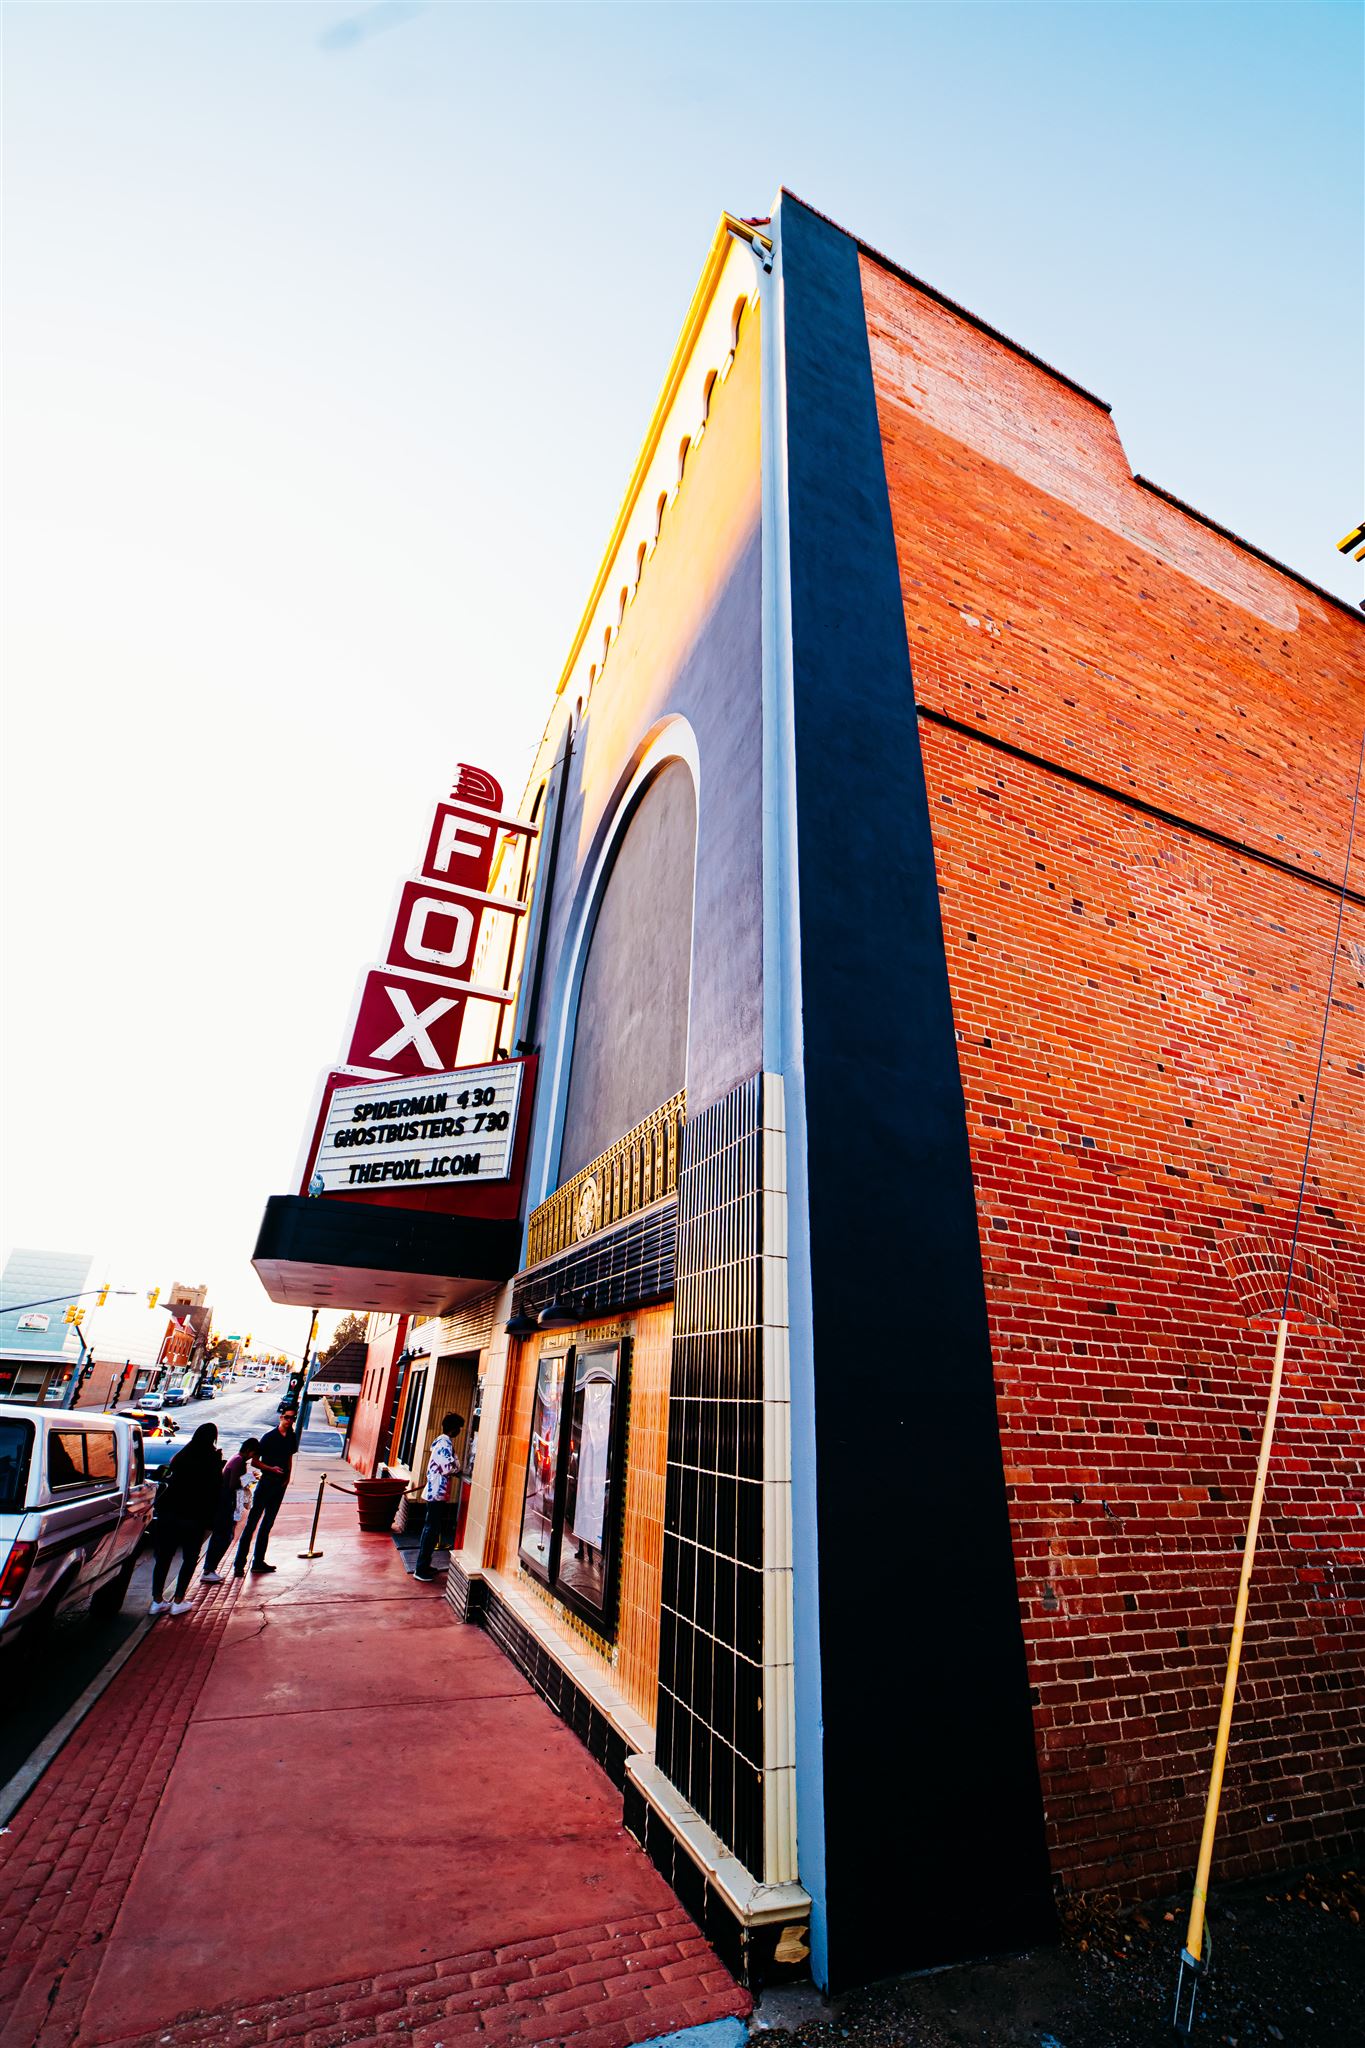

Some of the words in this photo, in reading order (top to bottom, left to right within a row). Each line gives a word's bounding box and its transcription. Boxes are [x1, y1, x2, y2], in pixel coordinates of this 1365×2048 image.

[369, 813, 491, 1070] FOX
[351, 1092, 447, 1122] SPIDERMAN
[334, 1116, 468, 1148] GHOSTBUSTERS
[472, 1110, 509, 1134] 730
